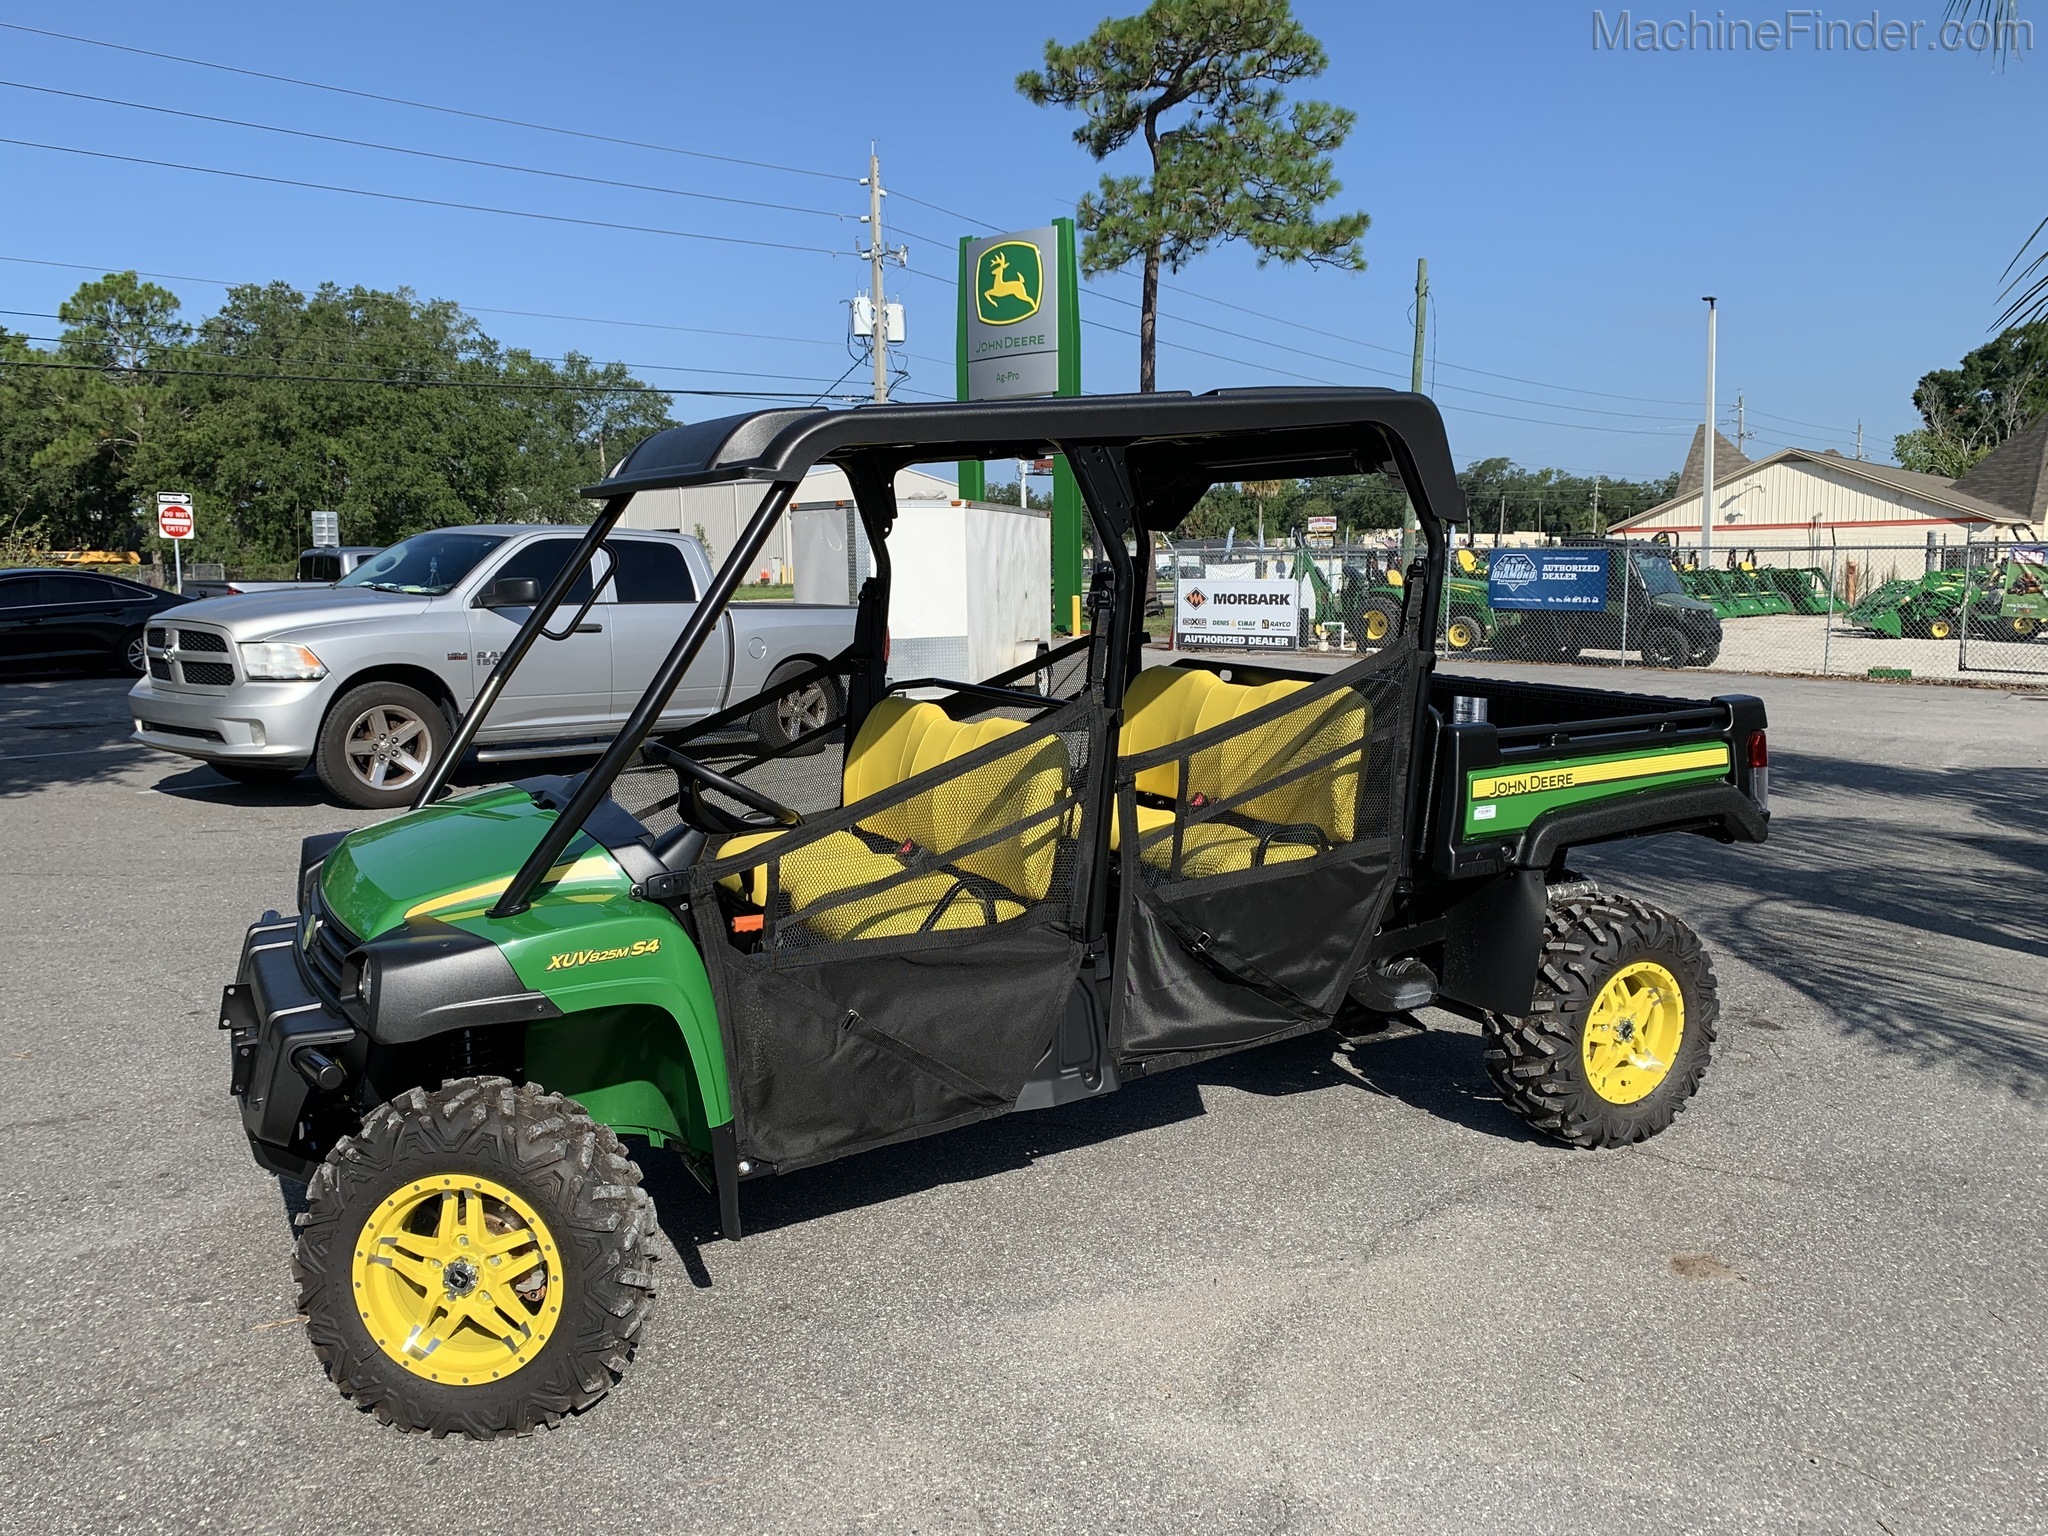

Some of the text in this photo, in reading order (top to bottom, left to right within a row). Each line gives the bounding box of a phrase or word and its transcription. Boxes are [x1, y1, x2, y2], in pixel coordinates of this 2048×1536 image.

[975, 334, 1045, 353] JOHN DEERE
[995, 371, 1020, 384] Ag-Pro
[165, 525, 188, 533] ENTER
[1503, 563, 1527, 572] BLUE
[1542, 564, 1600, 572] AUTHORIZED
[1493, 570, 1536, 580] DIAMOND
[1213, 593, 1291, 606] MORBARK
[1182, 618, 1207, 626] BOXER
[1184, 634, 1289, 646] AUTHORIZED DEALER
[1490, 773, 1574, 795] JOHN DEERE
[545, 938, 662, 972] XUV825M S4
